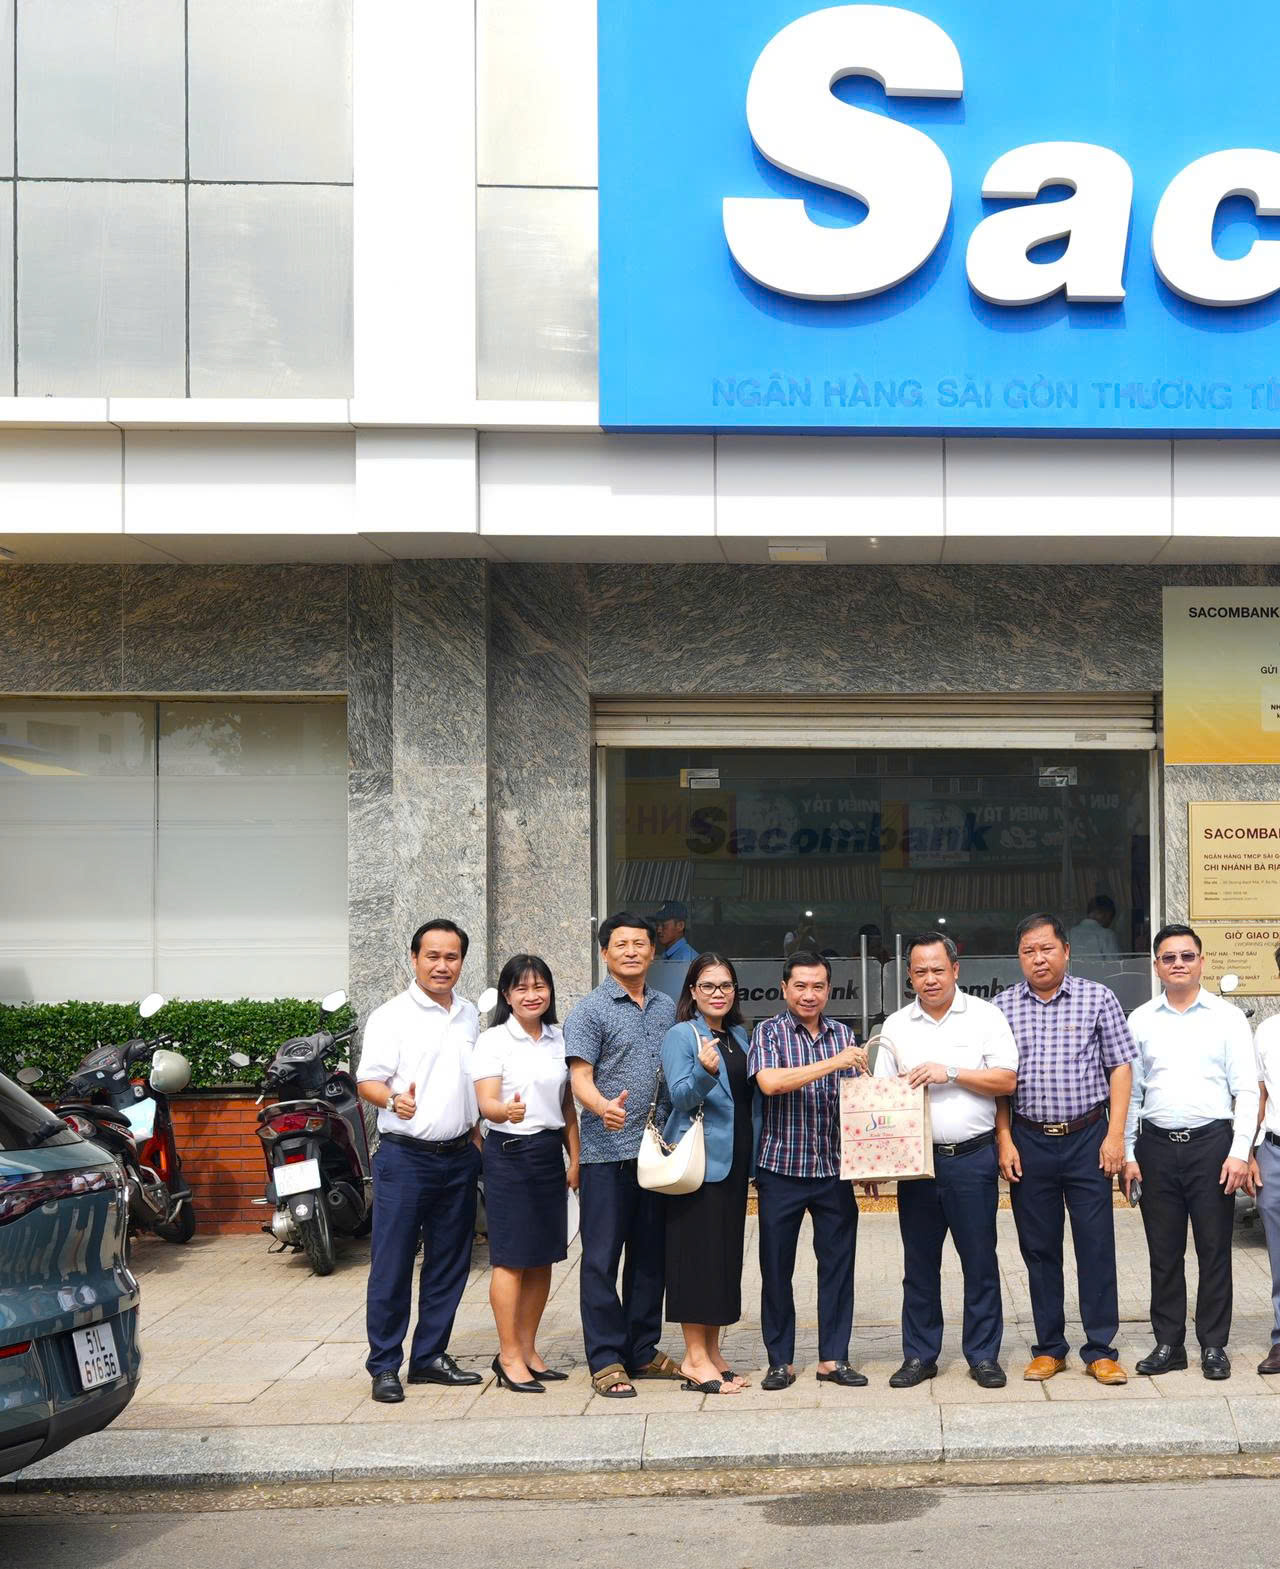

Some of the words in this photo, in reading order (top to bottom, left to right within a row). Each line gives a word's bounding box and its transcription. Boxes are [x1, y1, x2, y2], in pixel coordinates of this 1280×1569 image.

[711, 376, 812, 409] NGÂN
[823, 376, 924, 410] HÀNG
[936, 376, 993, 410] SÀI
[1003, 375, 1079, 410] GÒN
[1089, 376, 1233, 410] THƯƠNG
[1188, 606, 1280, 618] SACOMBANK
[1260, 664, 1278, 675] GỬI
[1221, 862, 1252, 871] NHÁNH
[1224, 930, 1243, 940] GIỜ
[1246, 931, 1270, 940] GIAO
[85, 1328, 105, 1354] 51L
[84, 1353, 117, 1384] 616.56
